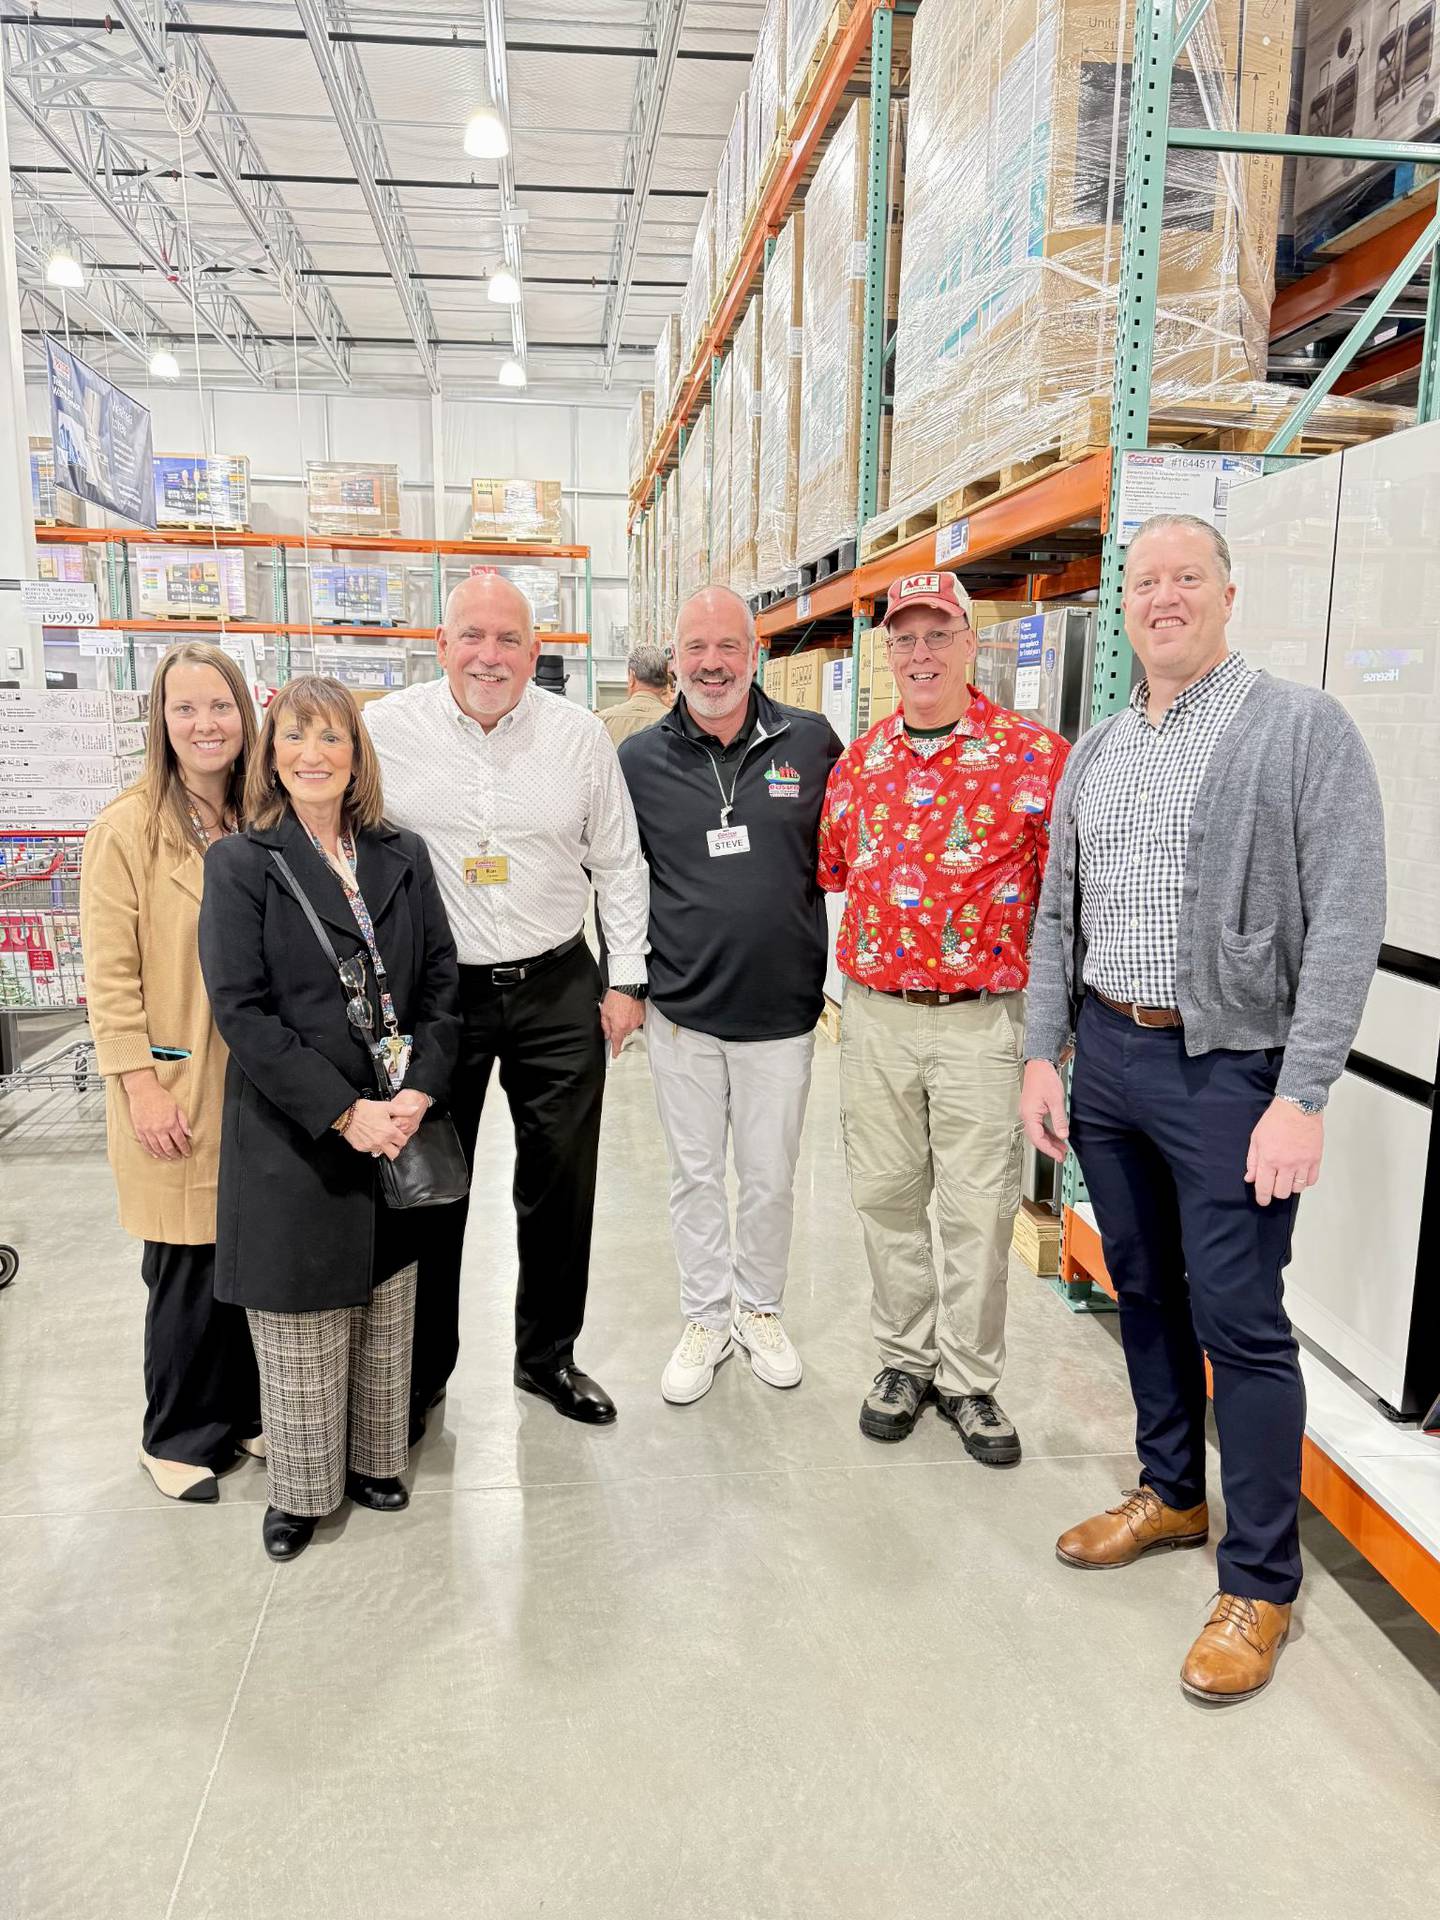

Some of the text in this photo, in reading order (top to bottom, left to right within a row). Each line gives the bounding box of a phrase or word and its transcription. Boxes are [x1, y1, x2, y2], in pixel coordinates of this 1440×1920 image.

[1103, 40, 1119, 50] 21.
[1268, 90, 1276, 104] CUT
[1171, 458, 1217, 470] #1644517
[904, 576, 938, 590] ACE
[96, 646, 123, 655] 119.99
[714, 839, 744, 850] STEVE
[936, 864, 957, 876] Happy
